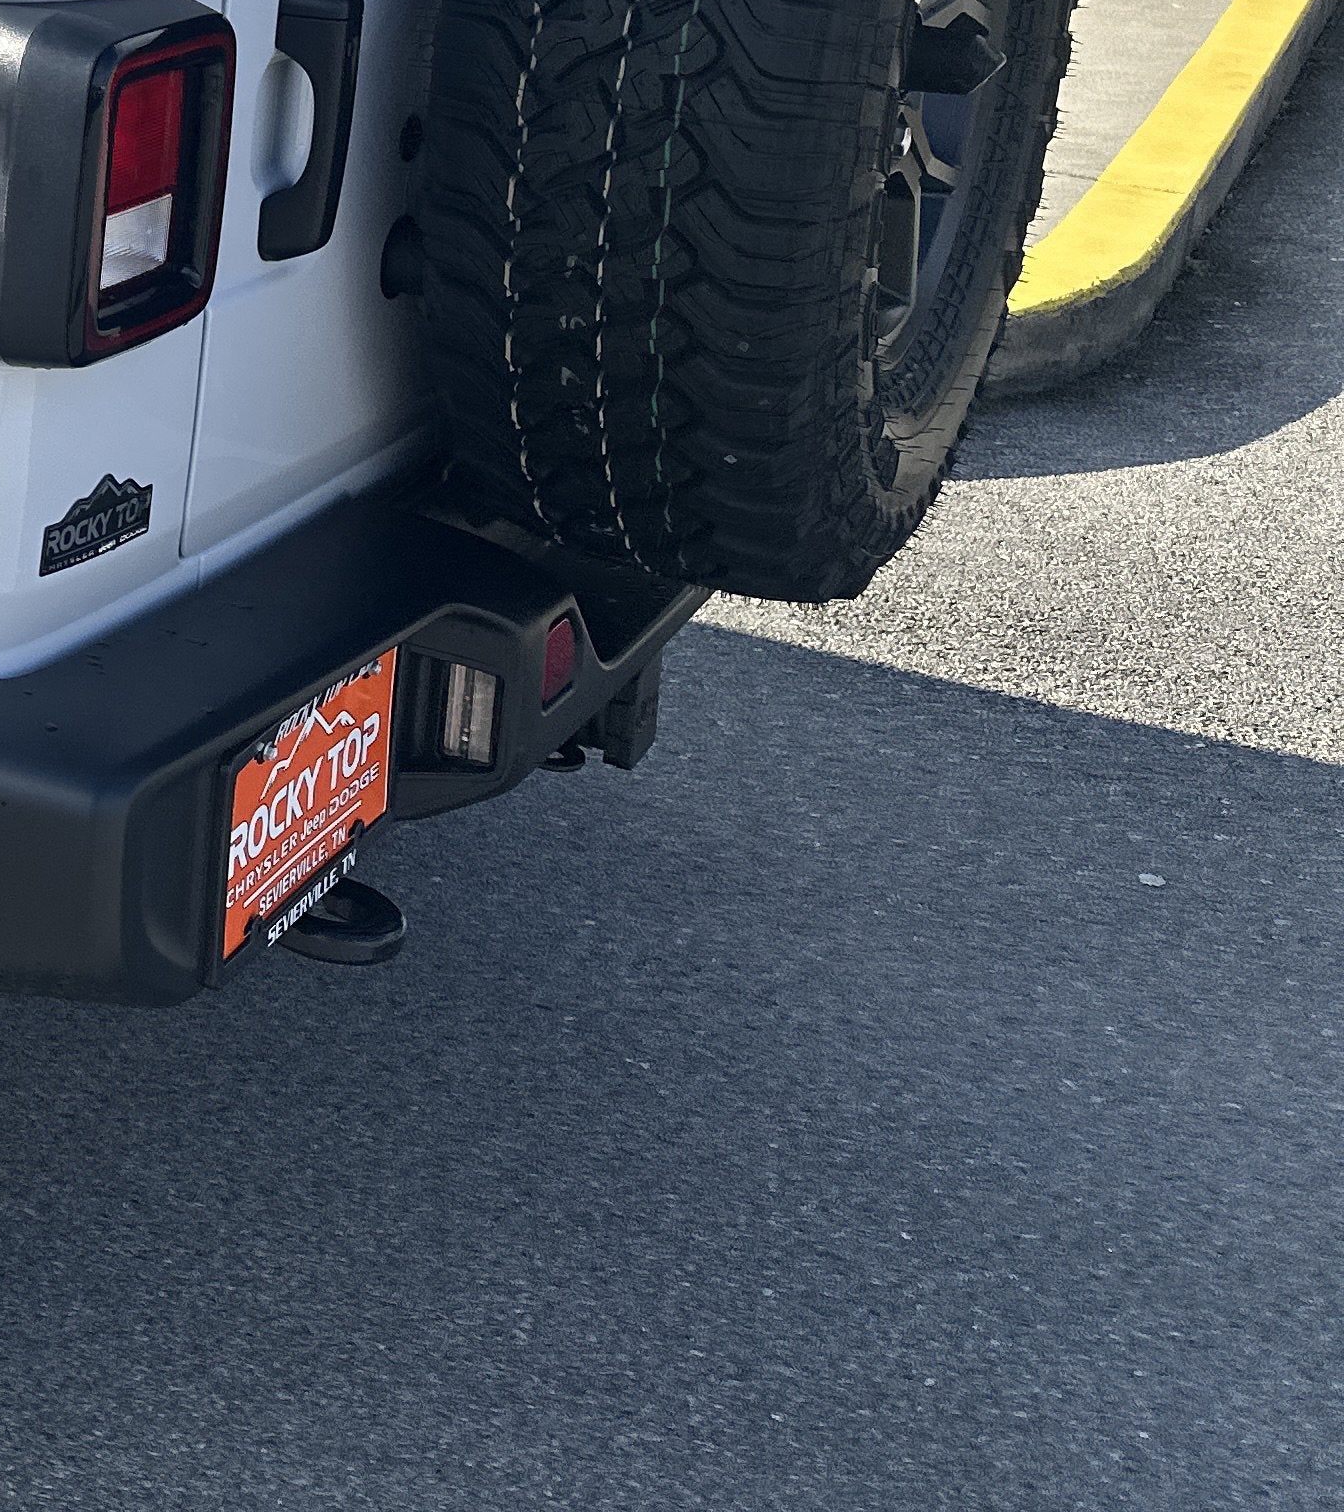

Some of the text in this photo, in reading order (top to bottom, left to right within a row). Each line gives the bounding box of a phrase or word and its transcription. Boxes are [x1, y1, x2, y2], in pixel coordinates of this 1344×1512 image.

[46, 508, 113, 556] ROCKY
[226, 762, 379, 909] CHRYSLER Jeep DODGE
[228, 713, 380, 881] ROCKY TOP
[258, 824, 348, 917] SEVIERVILLE, TN
[341, 849, 358, 875] TN
